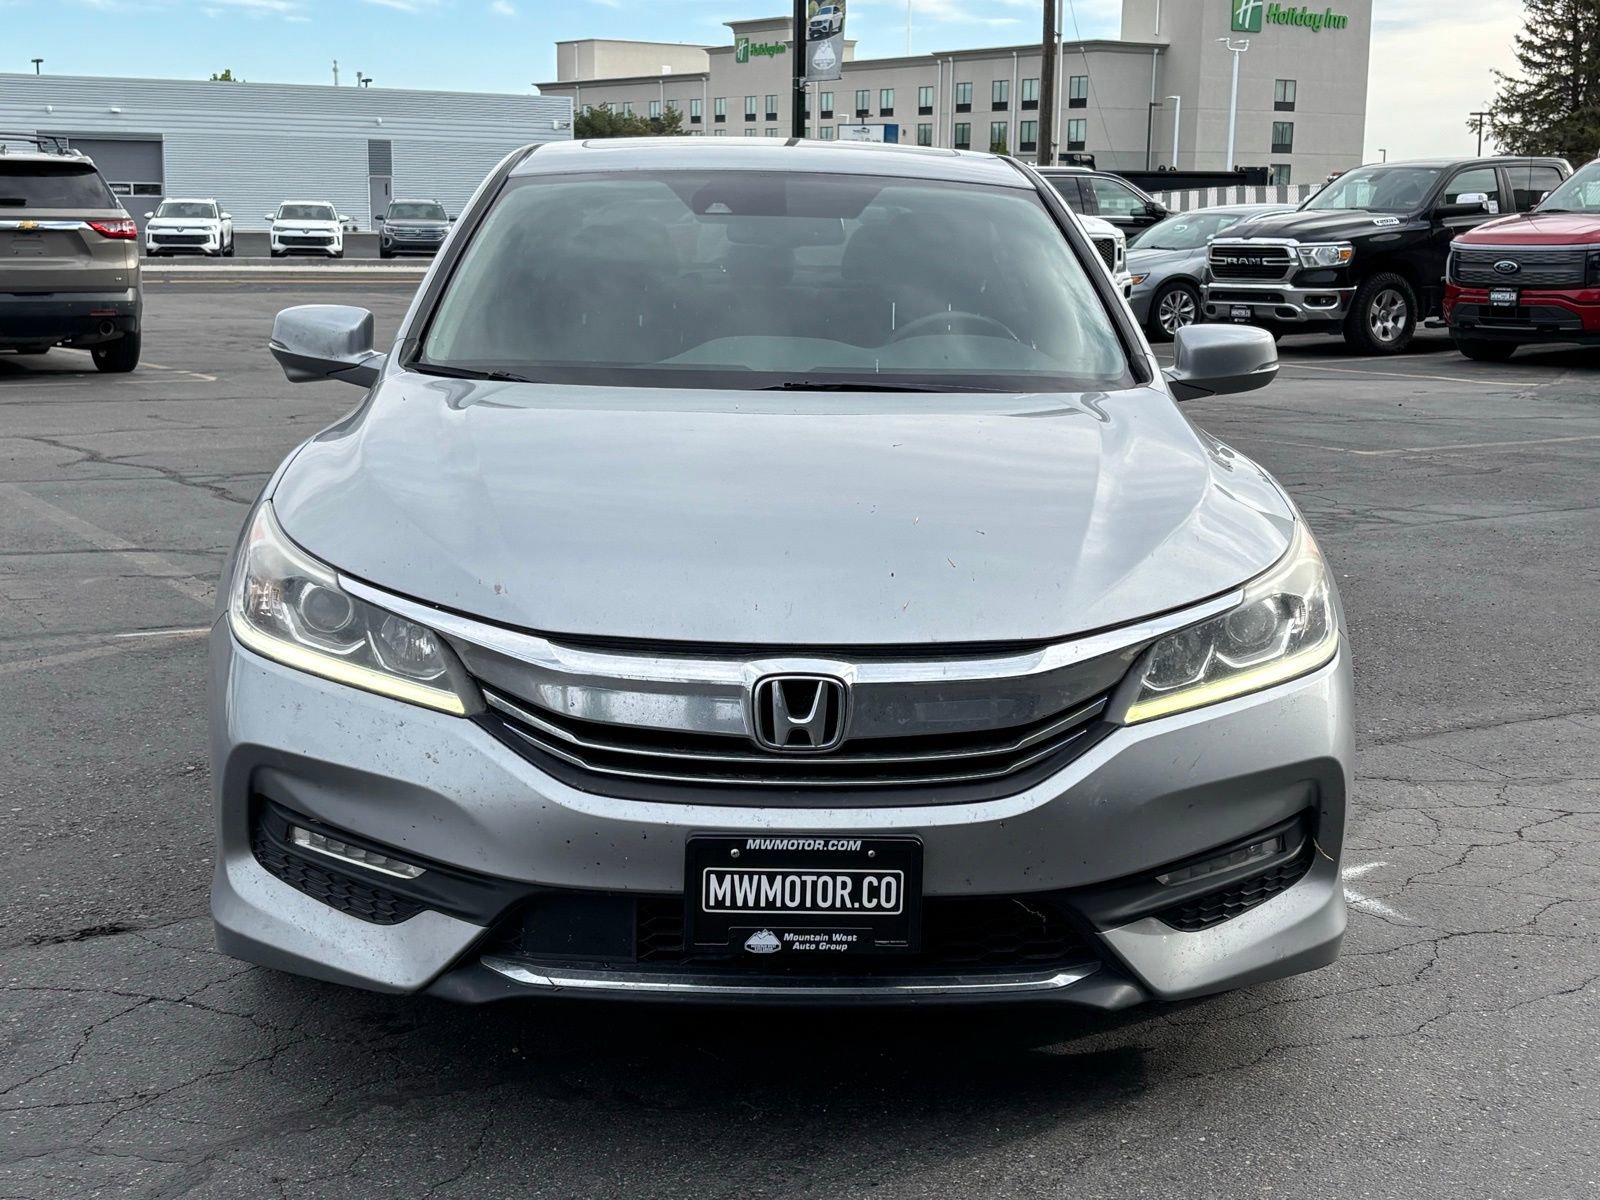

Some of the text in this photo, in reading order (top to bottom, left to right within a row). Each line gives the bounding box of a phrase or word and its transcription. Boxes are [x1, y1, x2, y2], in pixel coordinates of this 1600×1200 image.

[1266, 3, 1349, 33] Holiday Inn
[1227, 257, 1261, 265] RAM
[746, 839, 861, 851] MWMOTOR.COM
[709, 874, 897, 909] MWMOTOR.CO
[783, 932, 858, 942] Mountain West
[792, 942, 848, 952] Auto Group
